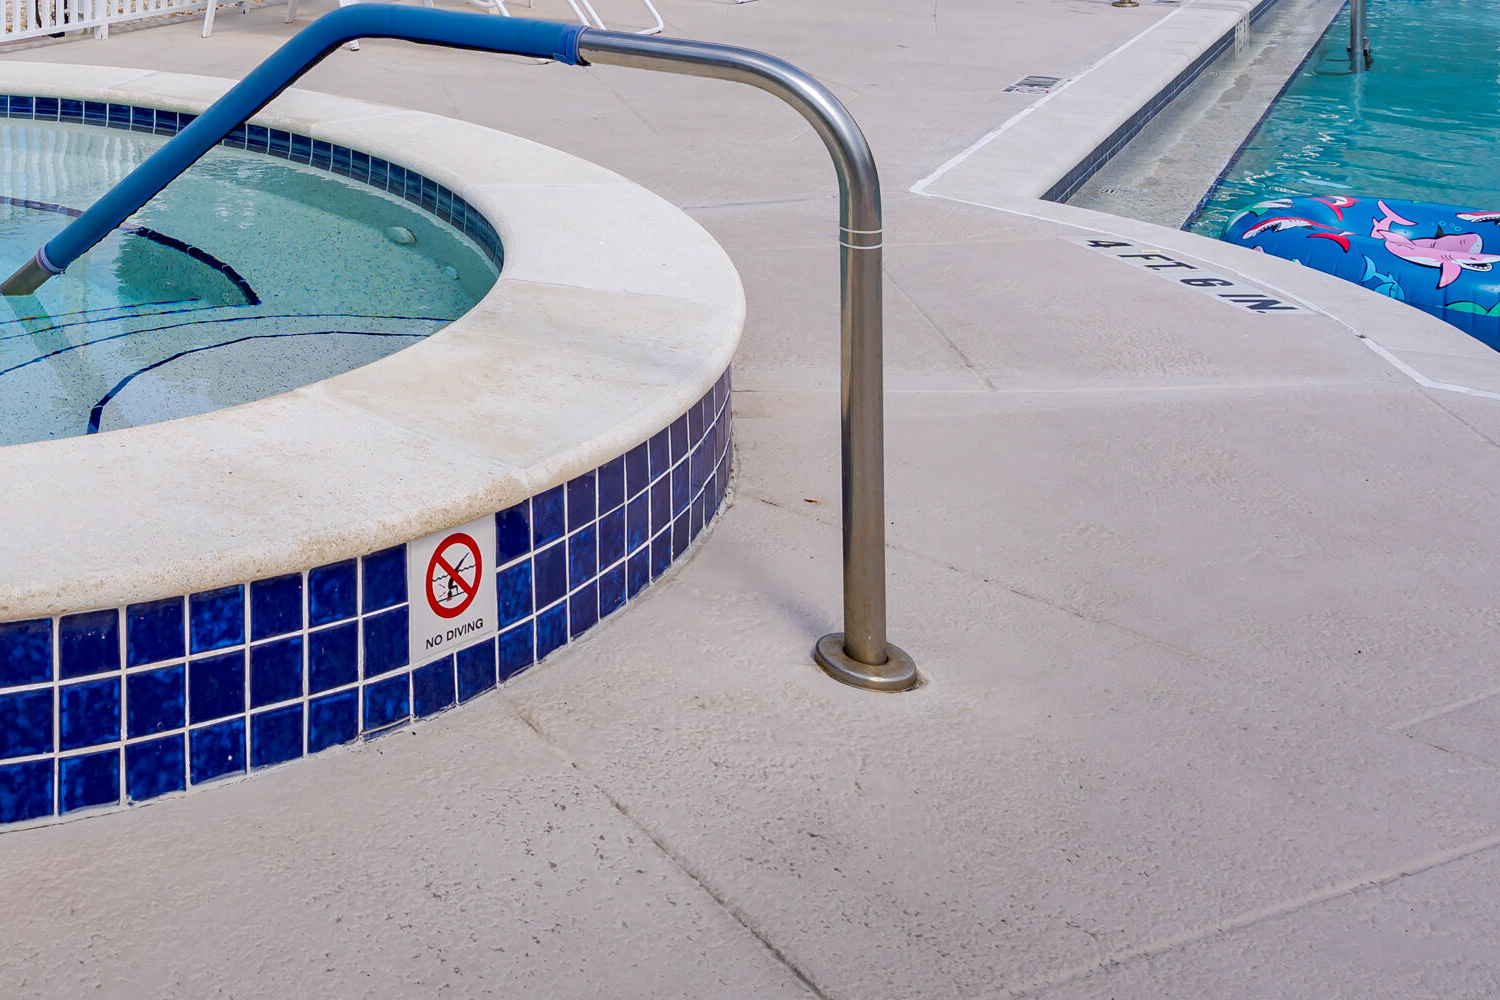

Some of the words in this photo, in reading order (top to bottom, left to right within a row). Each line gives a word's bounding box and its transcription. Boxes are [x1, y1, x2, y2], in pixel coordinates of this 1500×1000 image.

[1086, 239, 1133, 249] 4
[1117, 253, 1200, 271] FT.
[1179, 278, 1234, 287] 6
[1217, 294, 1300, 314] IN.
[425, 634, 443, 650] NO
[446, 618, 484, 642] DIVING
